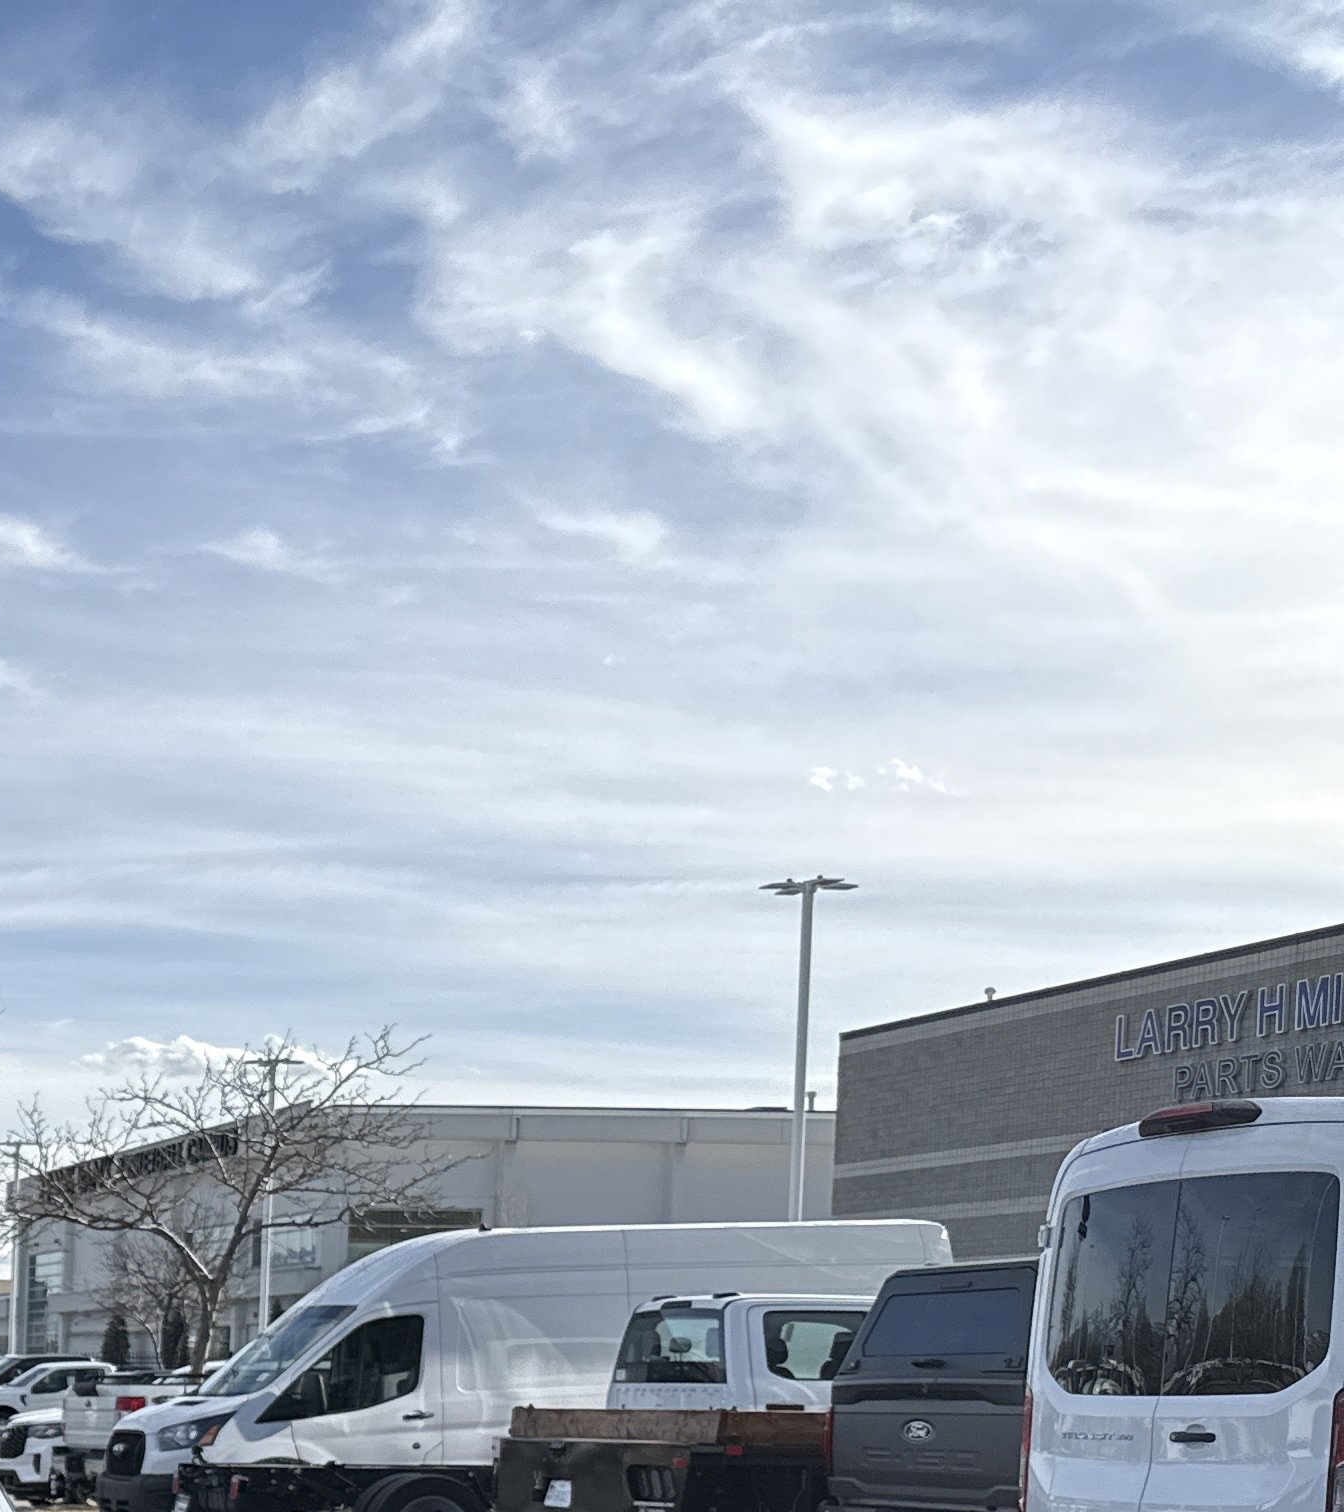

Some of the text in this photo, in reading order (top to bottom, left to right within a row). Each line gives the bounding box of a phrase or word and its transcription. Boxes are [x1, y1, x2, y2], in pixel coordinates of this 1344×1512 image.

[1114, 989, 1249, 1062] LARRY
[1256, 982, 1287, 1038] H
[1173, 1049, 1285, 1101] PARTS
